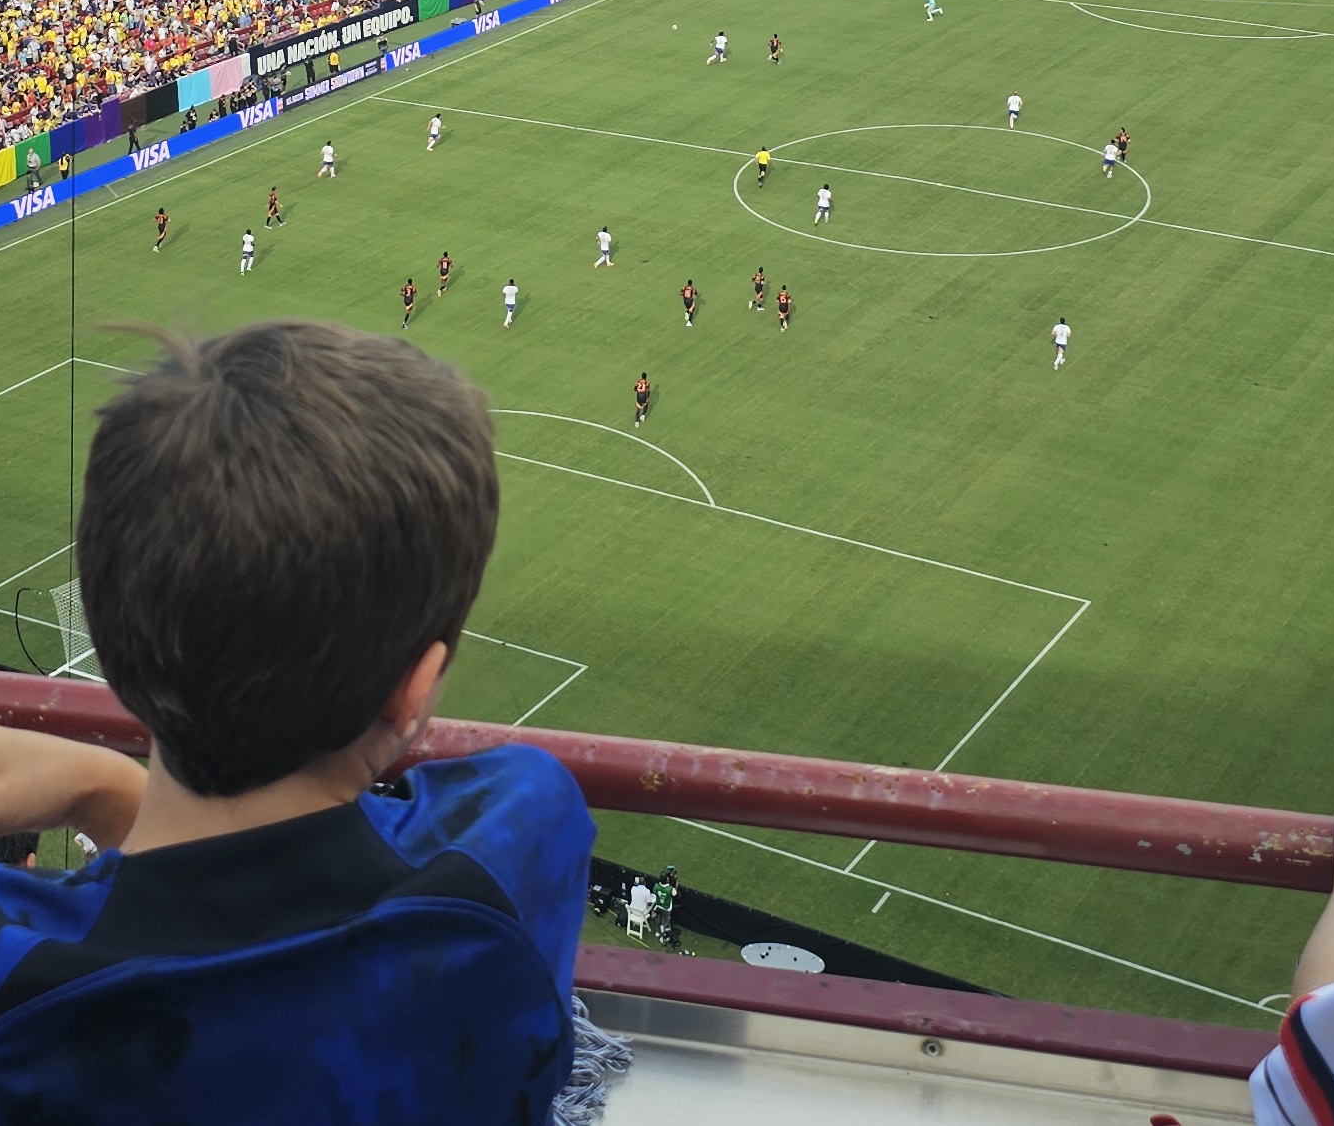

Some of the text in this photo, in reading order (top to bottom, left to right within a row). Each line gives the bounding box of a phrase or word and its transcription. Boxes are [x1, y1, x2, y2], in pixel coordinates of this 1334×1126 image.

[472, 10, 501, 34] VISA
[256, 5, 414, 76] UNA NACIÓN. UN EQUIPO.
[390, 42, 422, 68] VISA
[237, 99, 275, 128] VISA
[129, 141, 171, 171] VISA
[10, 186, 56, 219] VISA
